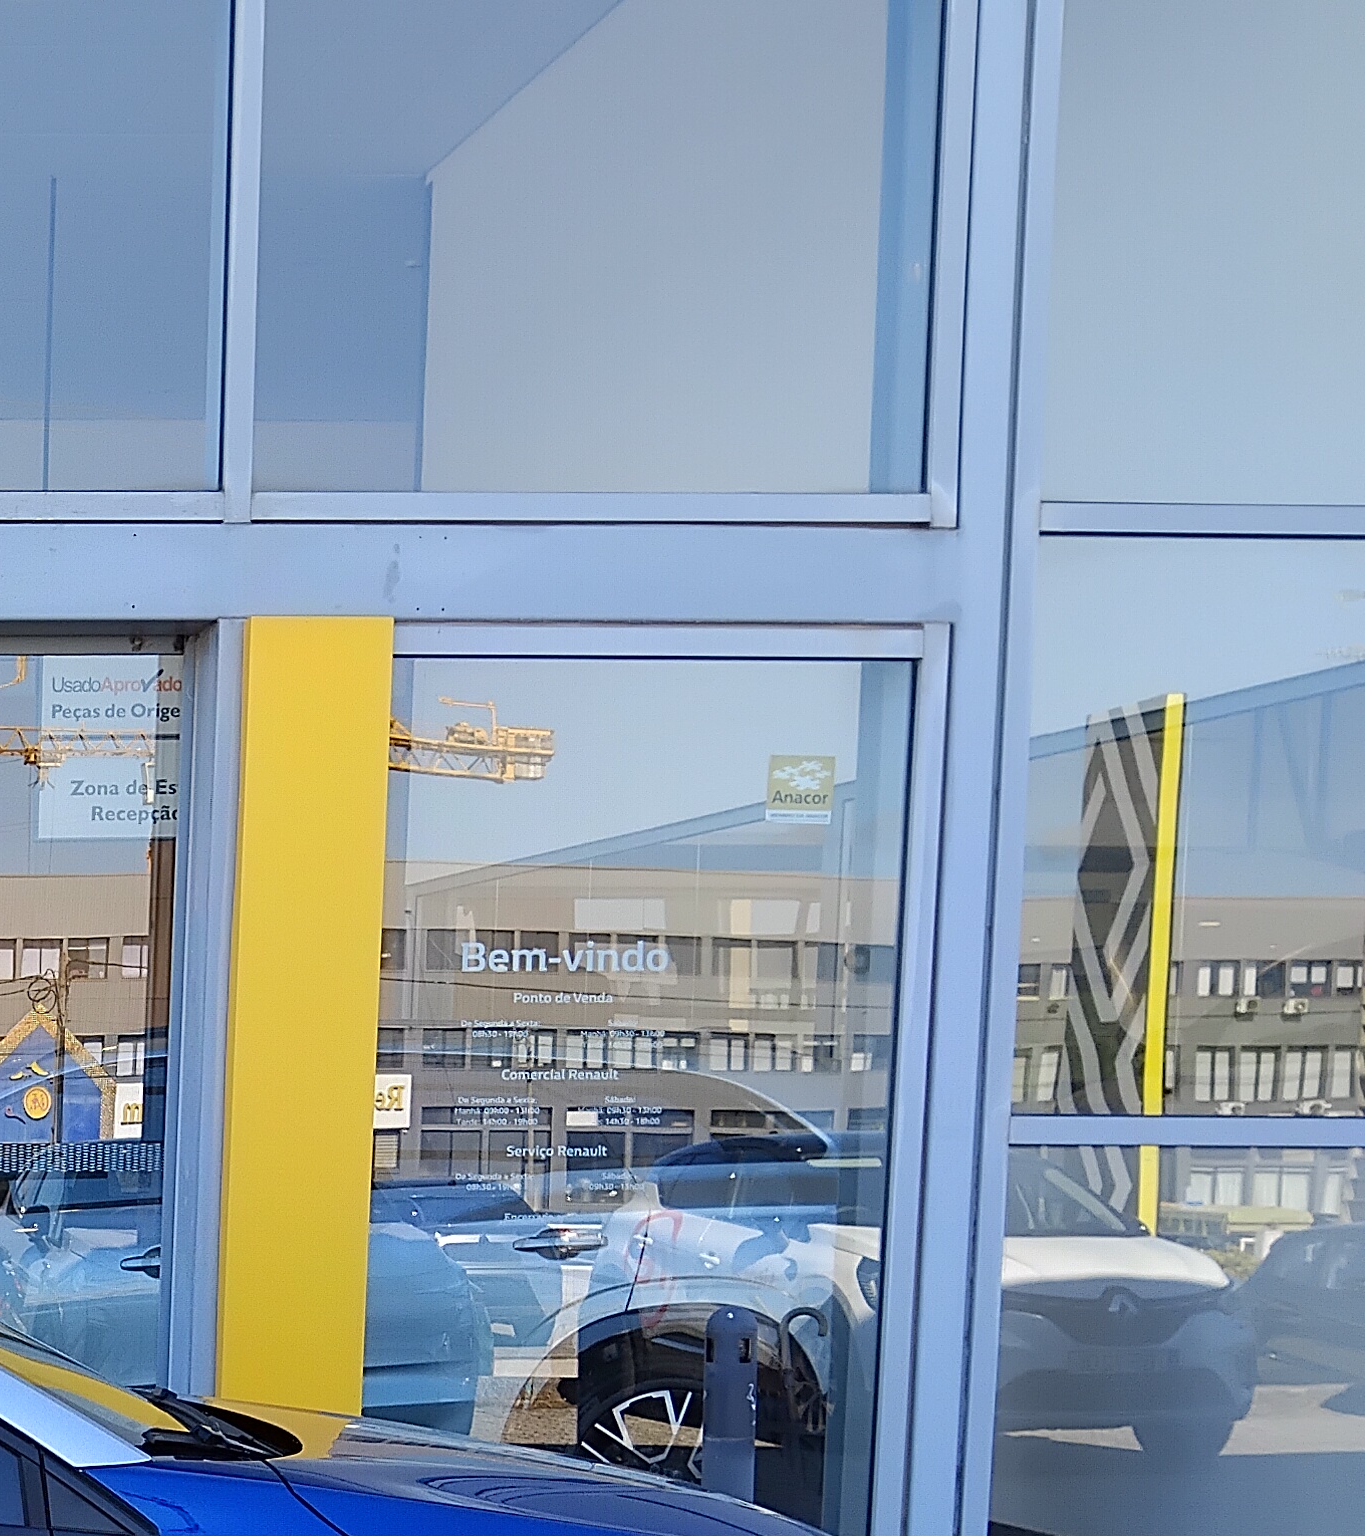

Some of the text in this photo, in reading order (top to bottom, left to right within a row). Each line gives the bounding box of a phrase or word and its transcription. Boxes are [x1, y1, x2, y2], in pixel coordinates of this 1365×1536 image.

[51, 703, 181, 722] Peças de Orige
[71, 780, 119, 796] Zona
[126, 779, 149, 796] de
[772, 790, 829, 805] Anacor
[461, 940, 670, 974] Bem-vindo
[513, 991, 613, 1004] Ponto de Venda
[501, 1069, 619, 1081] Comercial Renault
[506, 1145, 607, 1159] Serviço Renault
